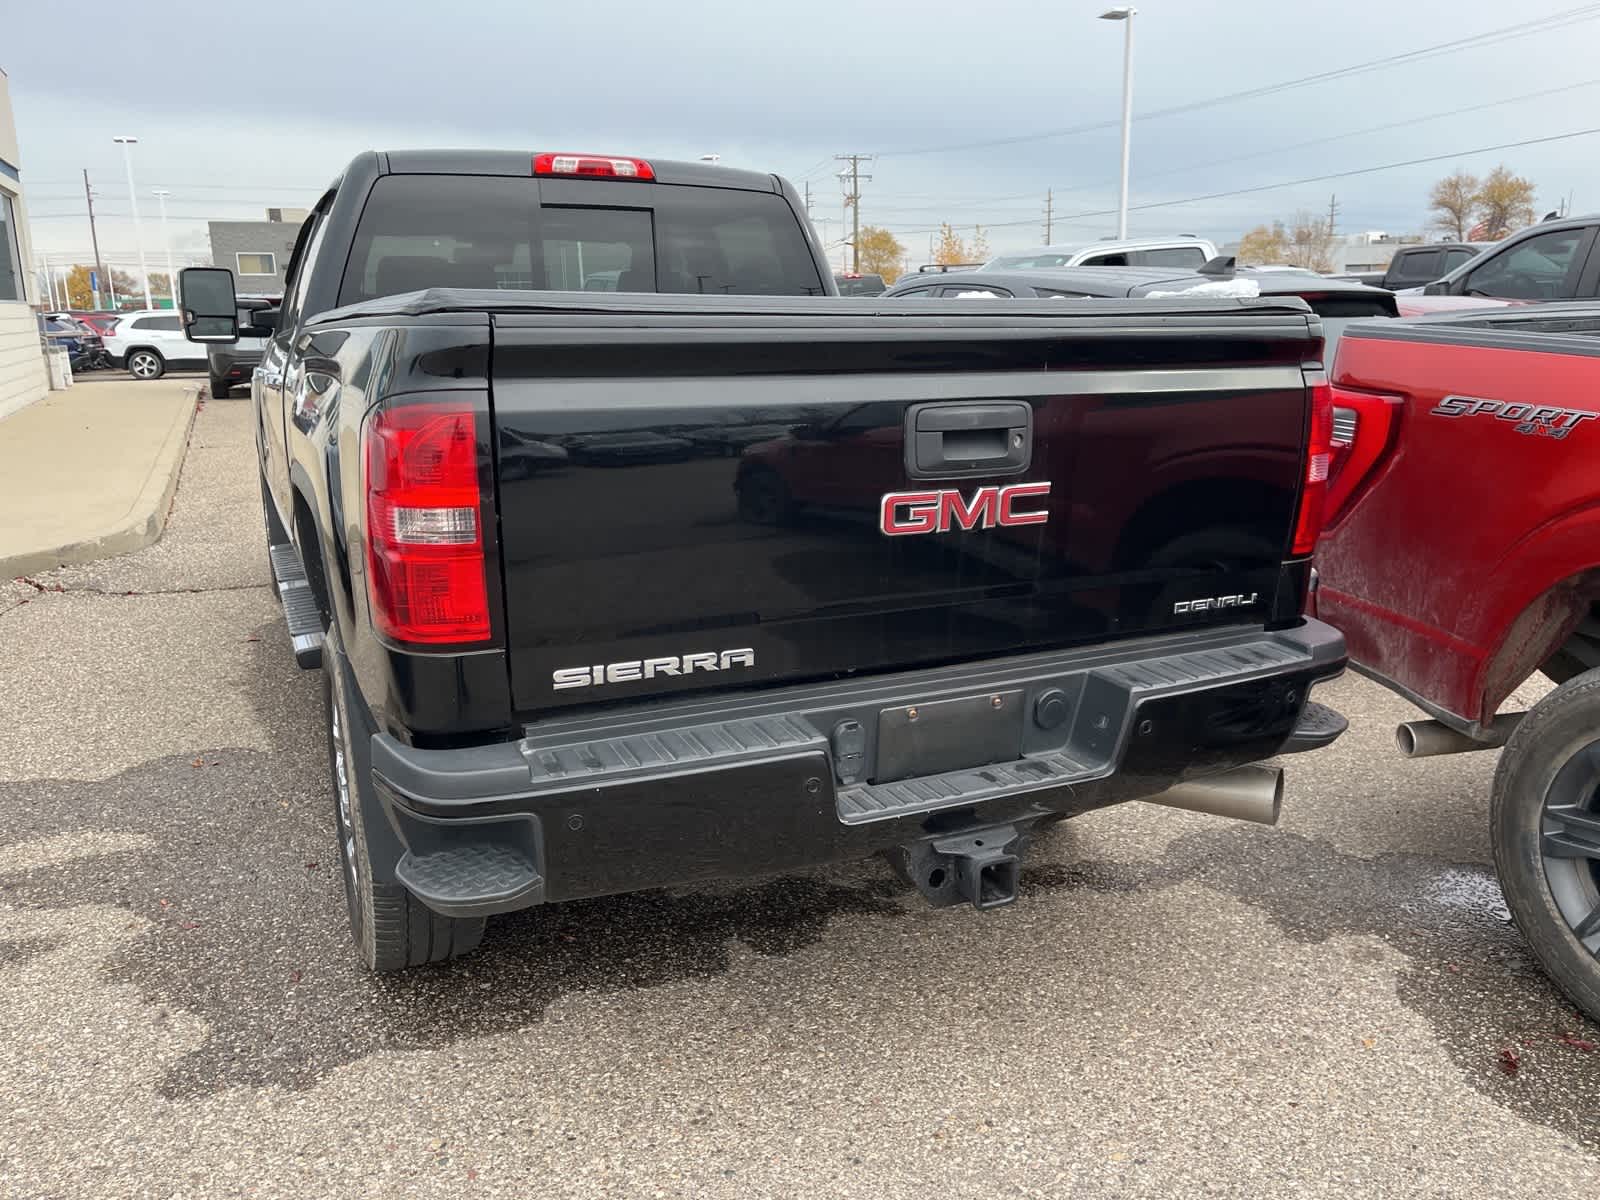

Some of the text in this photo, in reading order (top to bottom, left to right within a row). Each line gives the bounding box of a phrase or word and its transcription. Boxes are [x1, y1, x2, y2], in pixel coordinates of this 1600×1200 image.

[1430, 395, 1600, 428] SPORT
[880, 481, 1052, 536] GMC
[1173, 592, 1259, 615] DENALI
[552, 647, 755, 691] SIERRA
